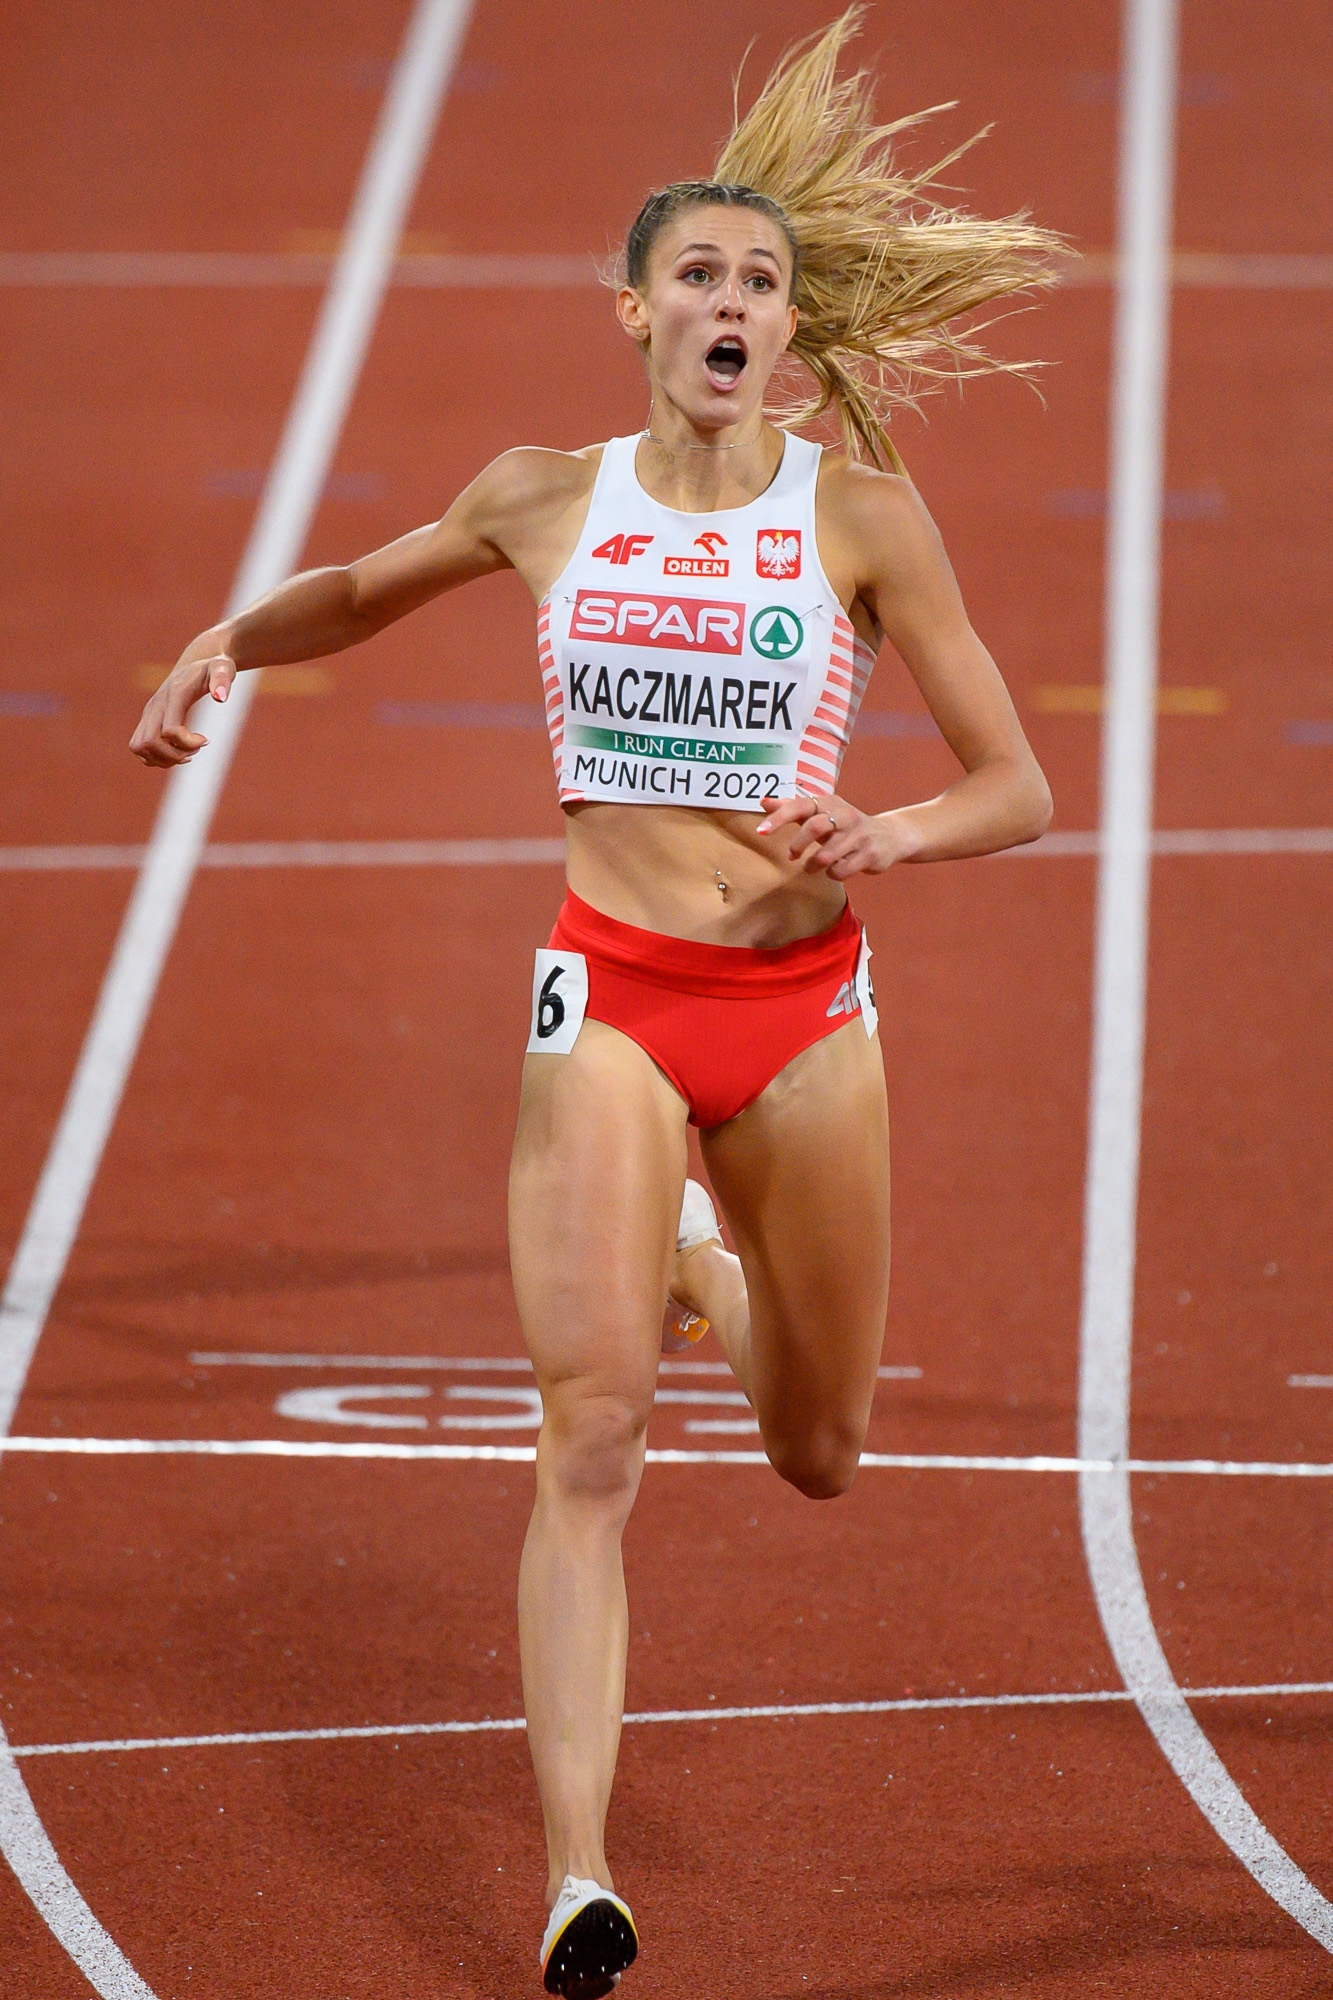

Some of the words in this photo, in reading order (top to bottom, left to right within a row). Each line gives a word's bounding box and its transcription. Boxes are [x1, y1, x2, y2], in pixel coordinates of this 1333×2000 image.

[591, 533, 655, 565] 4F
[667, 559, 725, 575] ORLEN
[575, 597, 740, 648] SPAR
[569, 662, 797, 730] KACZMAREK
[613, 732, 619, 750] I
[625, 733, 666, 755] RUN
[574, 755, 692, 796] MUNICH
[704, 771, 780, 799] 2022
[537, 965, 566, 1039] 6
